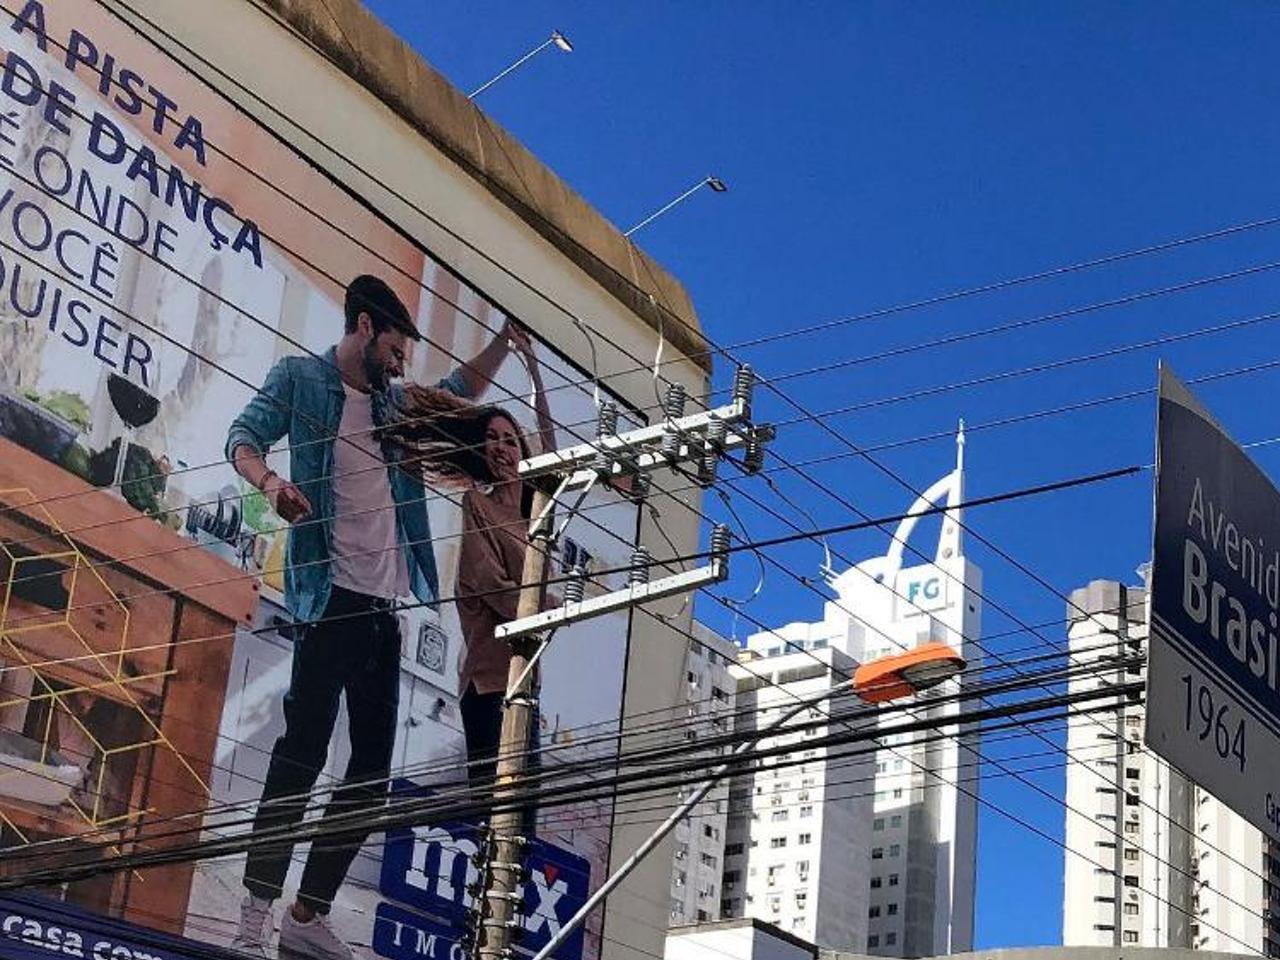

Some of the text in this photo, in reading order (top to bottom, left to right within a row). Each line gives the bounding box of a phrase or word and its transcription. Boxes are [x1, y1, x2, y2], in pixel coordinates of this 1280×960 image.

[11, 0, 207, 167] A PISTA
[1, 51, 263, 269] DE DANÇA
[33, 146, 179, 261] ONDE
[0, 253, 153, 387] UISER
[908, 576, 941, 602] FG
[1181, 673, 1248, 774] 1964
[2, 914, 84, 958] casa
[405, 826, 569, 940] mx
